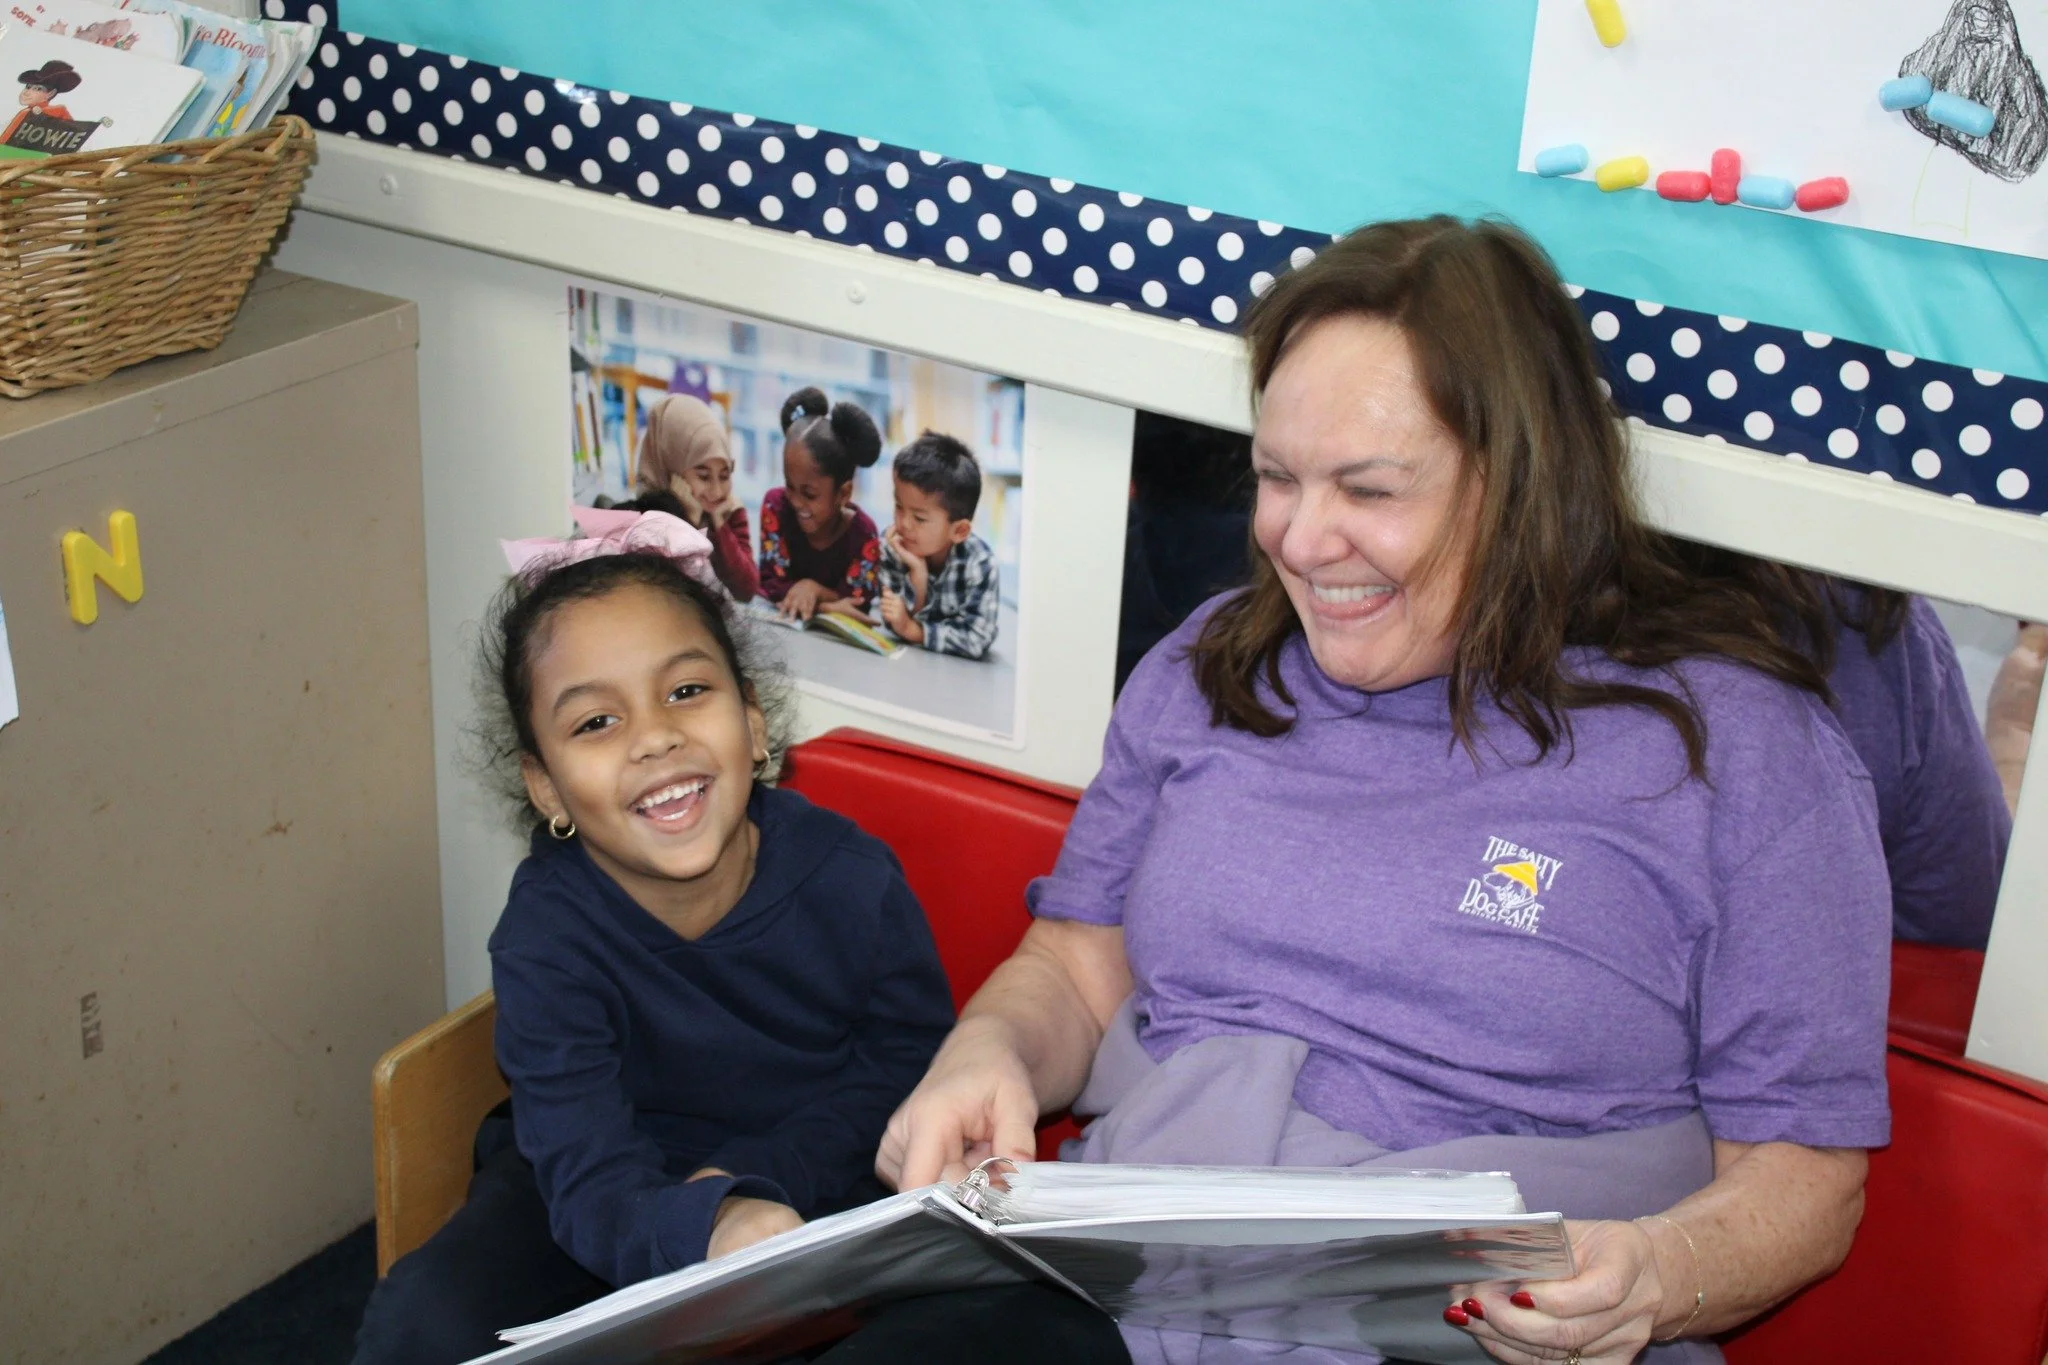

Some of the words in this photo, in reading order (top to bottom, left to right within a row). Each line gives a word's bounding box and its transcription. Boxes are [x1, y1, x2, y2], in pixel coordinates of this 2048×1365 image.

[15, 122, 87, 149] HOWIE
[62, 509, 144, 625] N
[1482, 835, 1520, 863] THE
[1519, 847, 1563, 890] SALTY
[1460, 878, 1498, 915] DOG
[1498, 903, 1545, 928] CAFE
